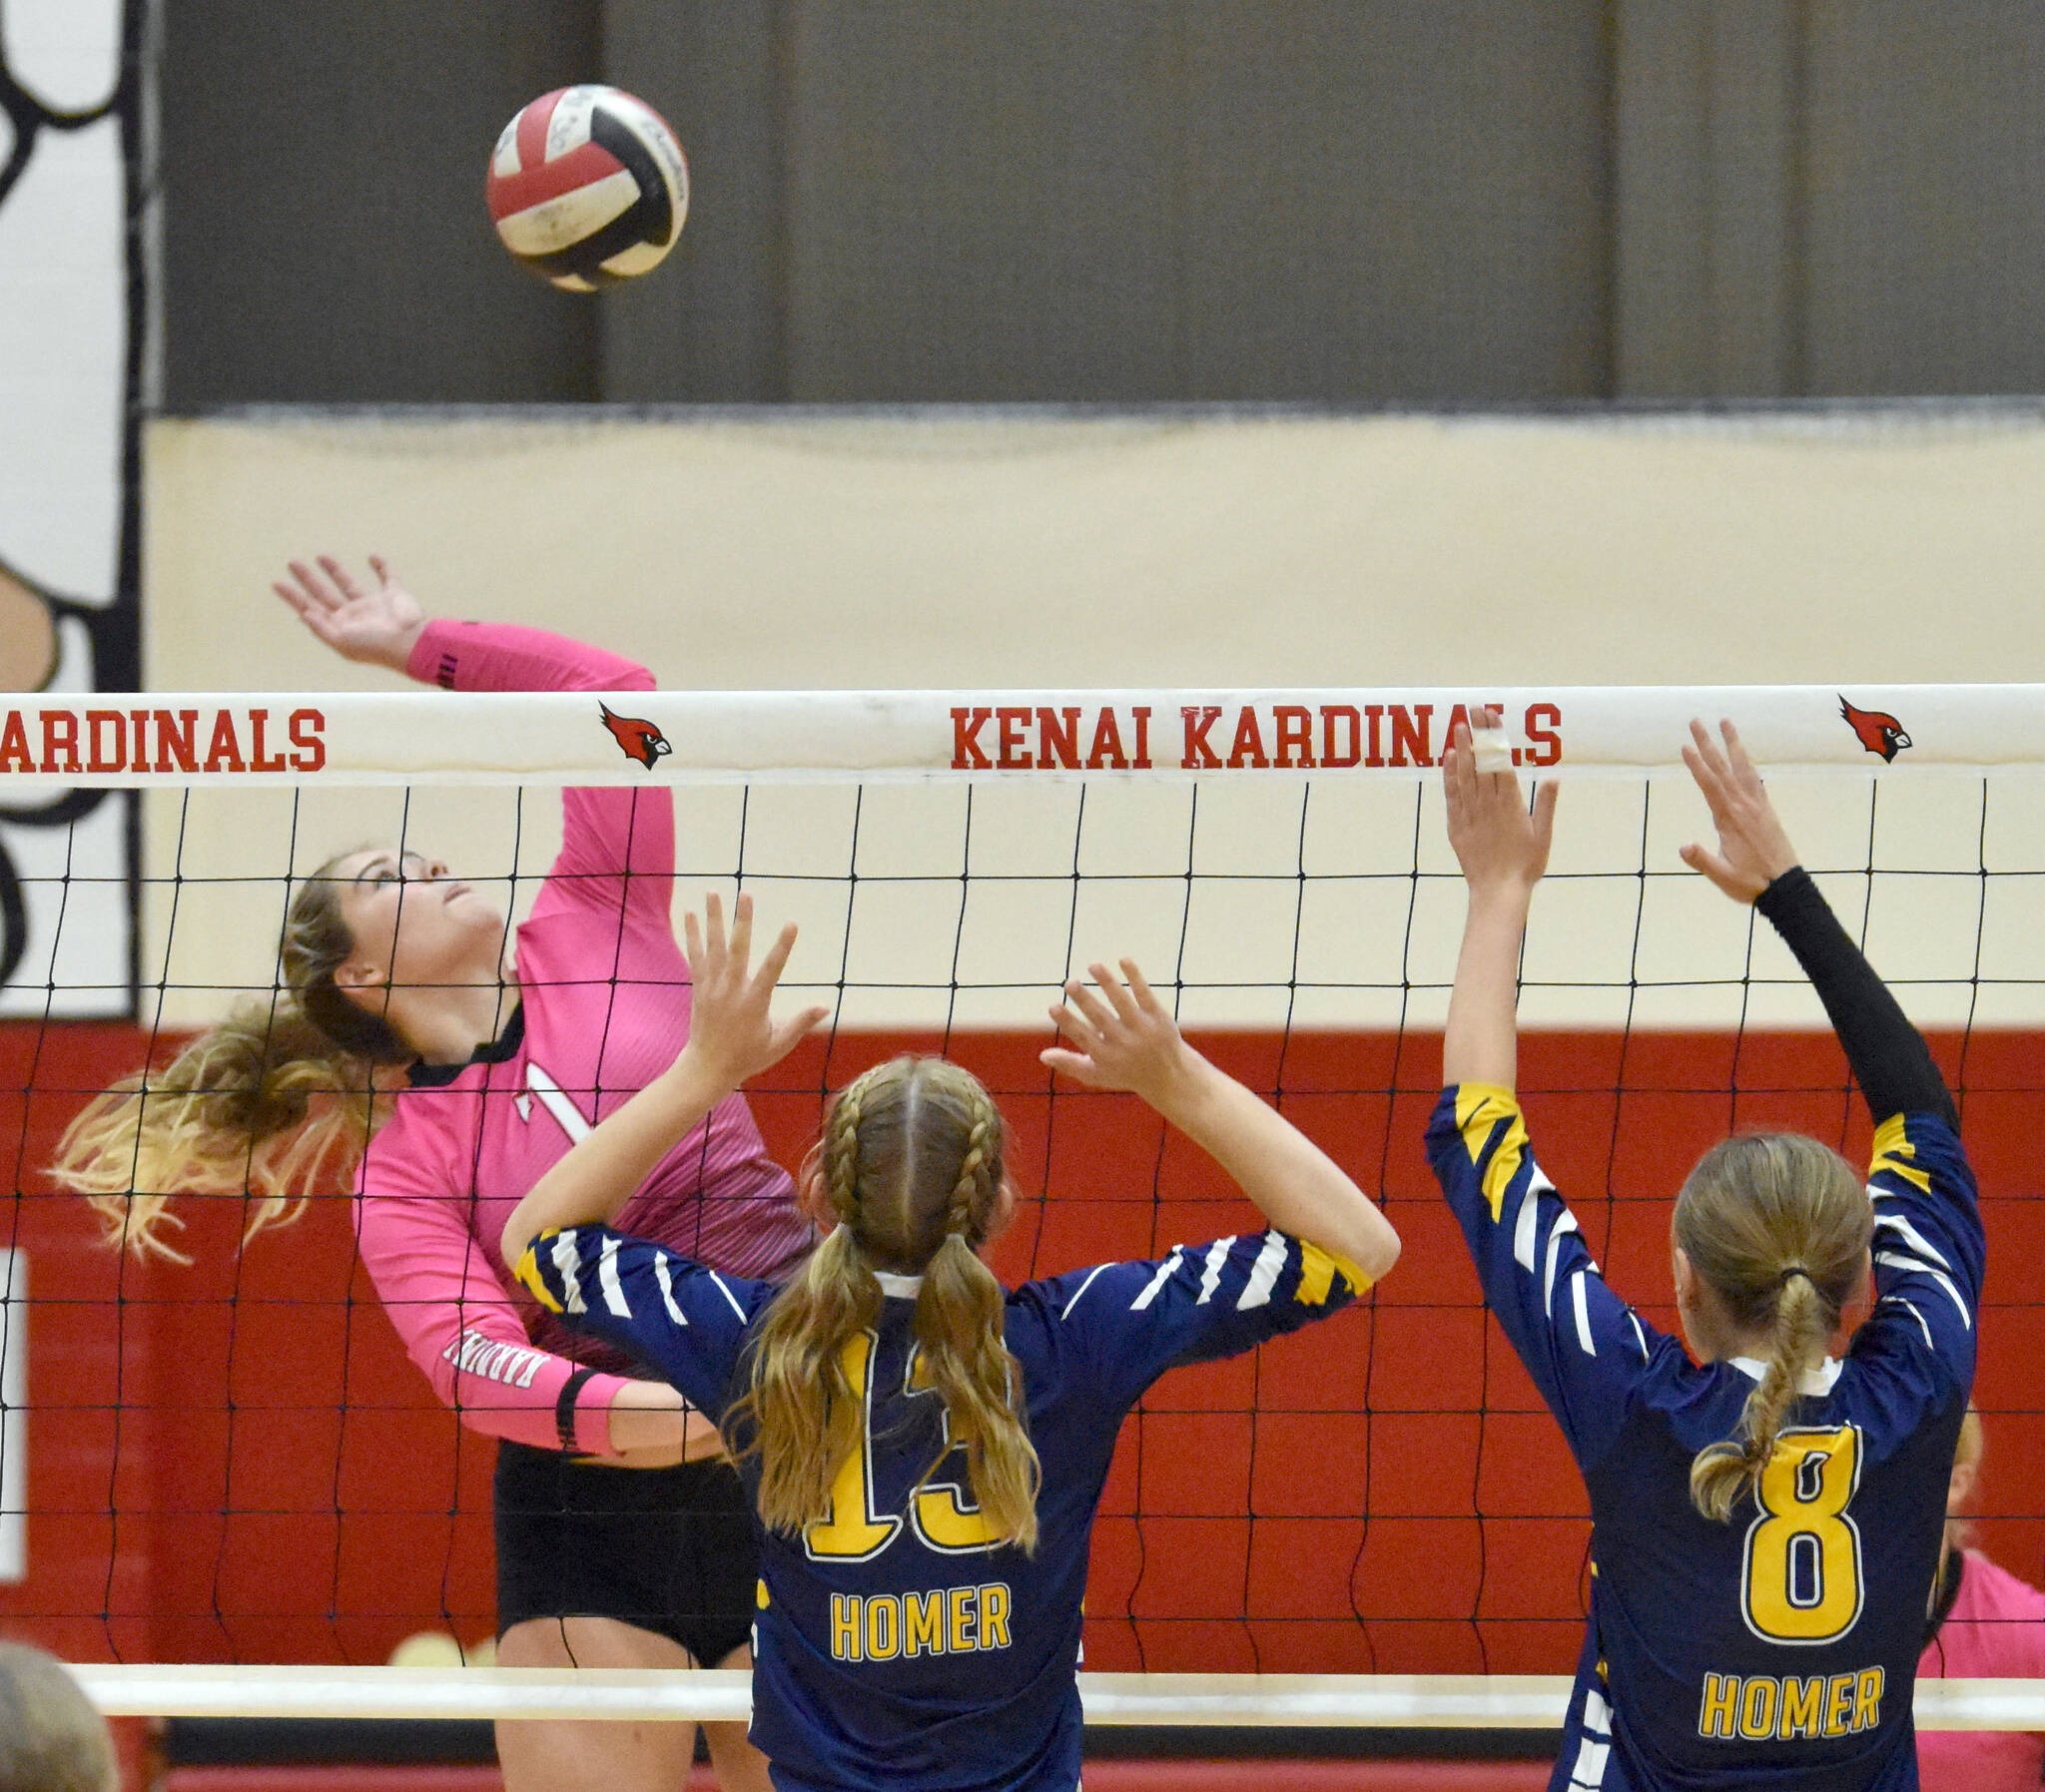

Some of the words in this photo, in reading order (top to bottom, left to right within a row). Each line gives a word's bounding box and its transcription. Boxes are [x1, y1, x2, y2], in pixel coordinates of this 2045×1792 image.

[951, 706, 1152, 769] KENAI
[1181, 704, 1562, 769] KARDINAS
[1739, 1422, 1865, 1646] 8
[830, 1581, 1013, 1662] HOMER
[1698, 1665, 1885, 1742] HOMER
